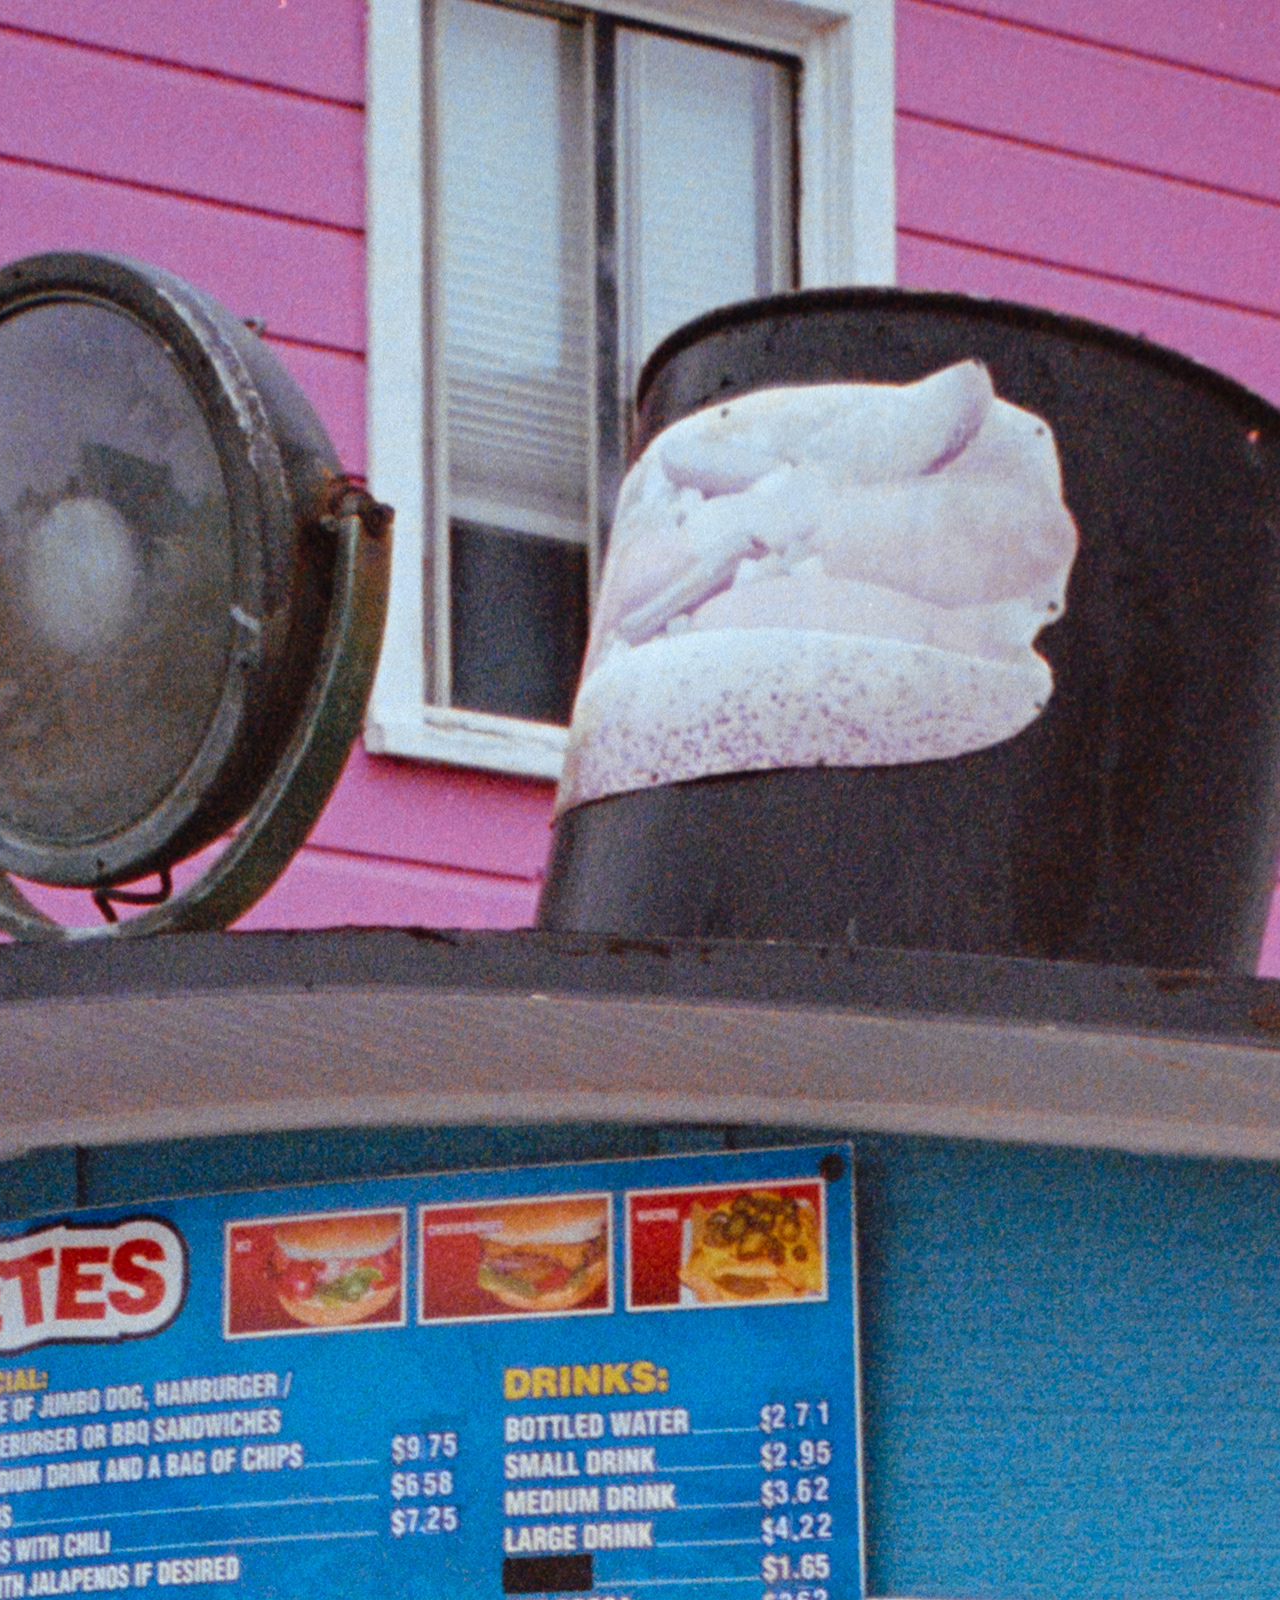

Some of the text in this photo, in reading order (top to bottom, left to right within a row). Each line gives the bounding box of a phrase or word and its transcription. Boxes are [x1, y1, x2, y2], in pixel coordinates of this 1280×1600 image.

[12, 1396, 35, 1422] OF
[38, 1388, 101, 1419] JUMBO
[104, 1384, 149, 1412] DOG,
[154, 1371, 278, 1407] HAMBURGER
[503, 1361, 669, 1400] DRINKS:
[81, 1423, 107, 1450] OR
[111, 1418, 150, 1448] BBQ
[153, 1408, 282, 1443] SANDWICHES
[505, 1408, 689, 1443] BOTTLED WATER
[46, 1459, 100, 1489] DRINK
[104, 1454, 144, 1484] AND
[147, 1454, 161, 1480] A
[165, 1450, 206, 1478] BAG
[210, 1446, 238, 1474] OF
[241, 1441, 305, 1472] CHIPS
[504, 1447, 656, 1480] SMALL DRINK
[760, 1439, 832, 1472] $2.95
[505, 1482, 677, 1516] MEDIUM DRINK
[761, 1475, 829, 1509] $3.62
[15, 1533, 60, 1563] WITH
[64, 1529, 111, 1558] CHILI
[504, 1521, 653, 1553] LARGE DRINK
[761, 1513, 832, 1546] $4.22
[28, 1563, 130, 1597] JALAPENOS
[133, 1561, 153, 1588] IF
[156, 1555, 240, 1586] DESIRED
[762, 1553, 830, 1583] $1.65
